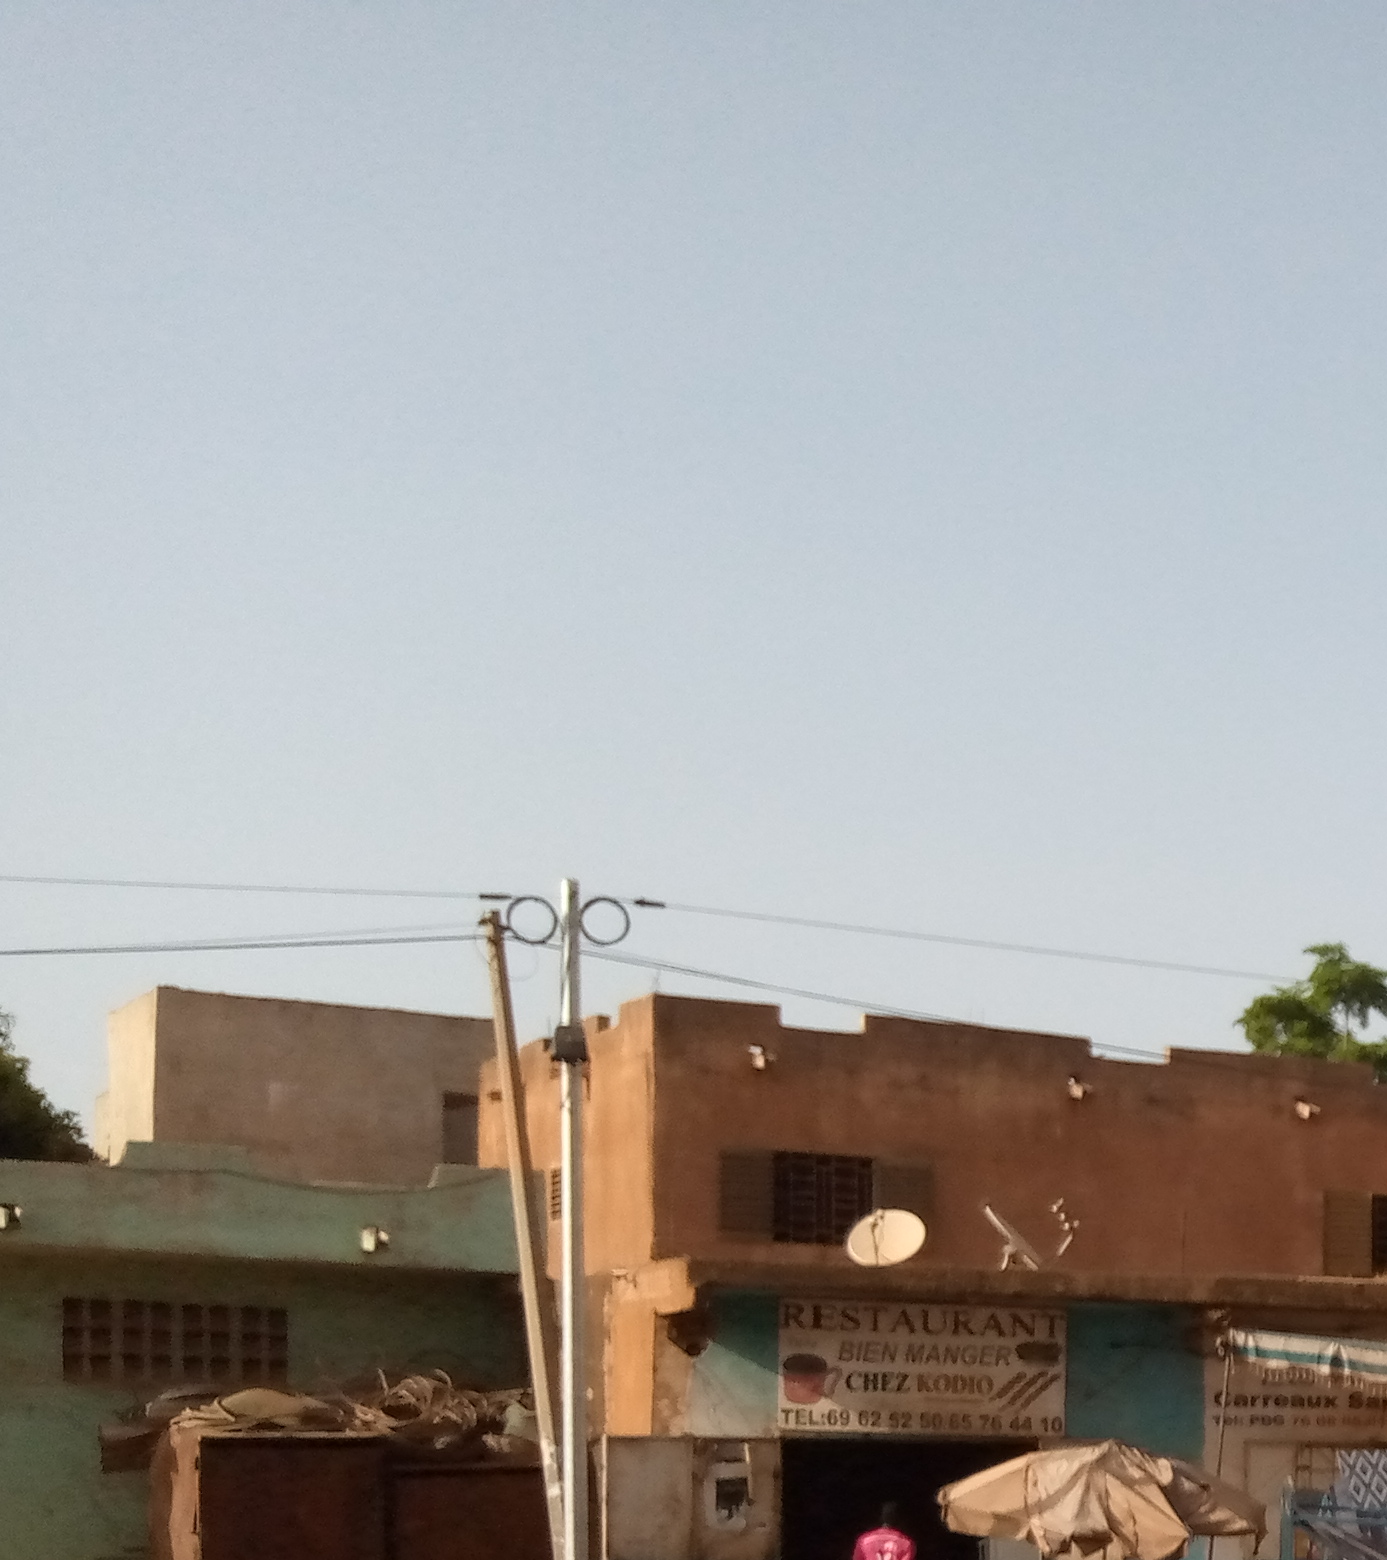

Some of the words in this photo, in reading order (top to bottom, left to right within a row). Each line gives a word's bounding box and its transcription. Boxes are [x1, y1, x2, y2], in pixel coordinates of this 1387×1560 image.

[781, 1303, 1066, 1338] RESTAURANT
[838, 1341, 898, 1363] BIEN
[904, 1343, 1011, 1367] MANGER
[845, 1371, 910, 1393] CHEZ
